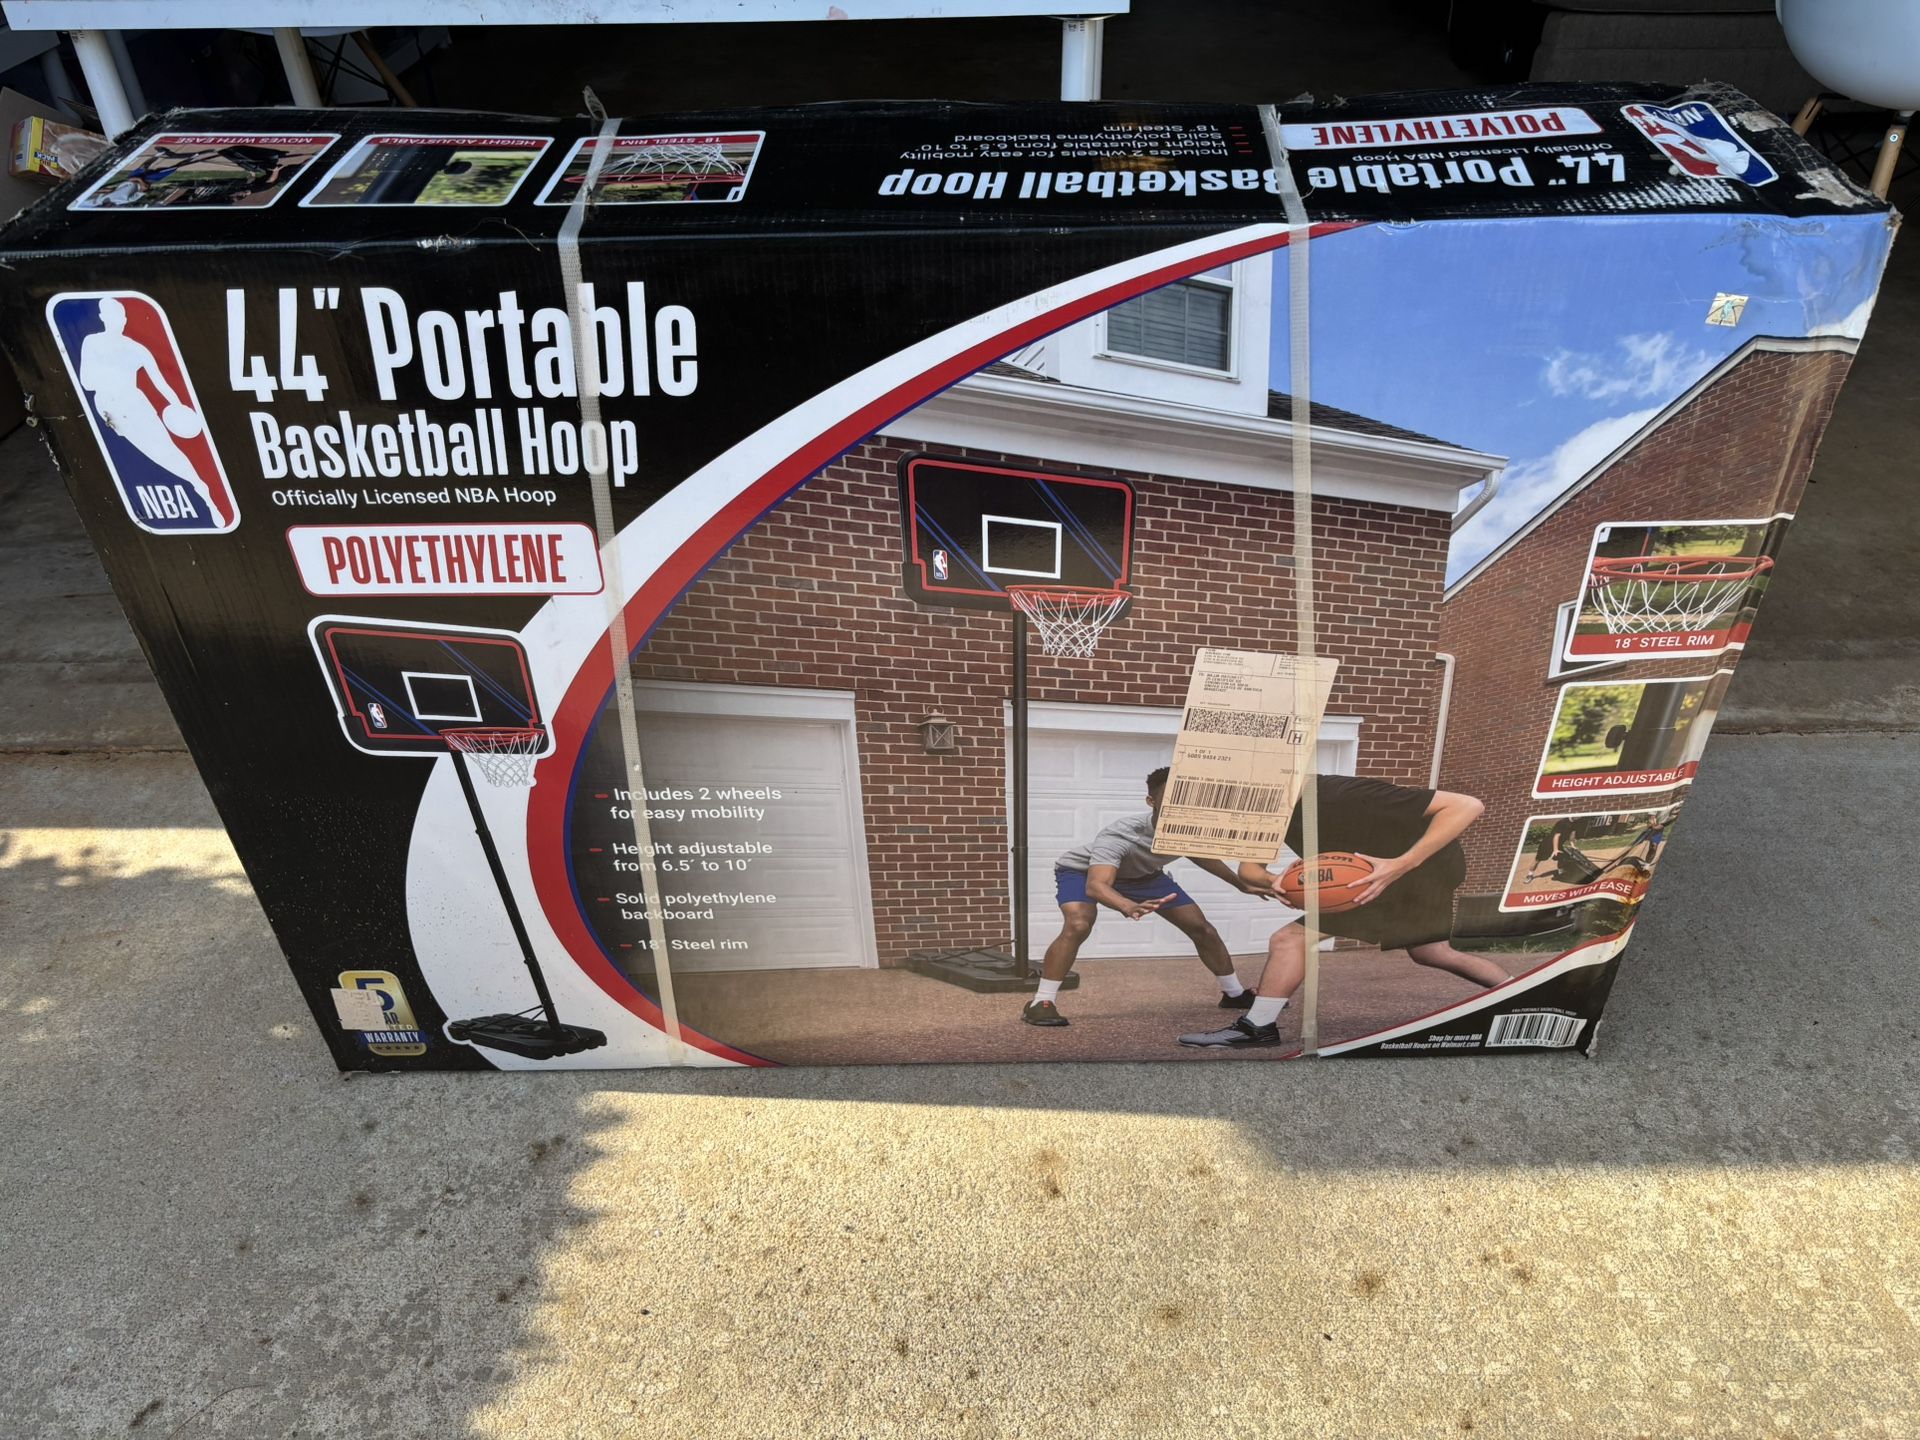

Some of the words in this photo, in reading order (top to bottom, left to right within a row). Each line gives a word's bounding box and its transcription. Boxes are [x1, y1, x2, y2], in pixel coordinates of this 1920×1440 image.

[1312, 112, 1566, 145] POLYETHYLENE
[479, 138, 535, 146] HEIGHT
[955, 134, 1050, 142] backboard
[1056, 132, 1170, 141] polyethylene
[1063, 140, 1159, 148] adjustable
[1165, 140, 1226, 148] Height
[1535, 143, 1612, 155] Officially
[900, 151, 974, 160] mobility
[980, 150, 1023, 158] easy
[1029, 150, 1054, 158] for
[1061, 149, 1126, 157] wheels
[1131, 149, 1143, 157] 2
[1150, 148, 1228, 156] Includes
[1352, 153, 1404, 163] Hoop
[1408, 151, 1444, 160] NBA
[1450, 148, 1529, 158] Licensed
[1549, 152, 1626, 185] 44"
[1307, 156, 1534, 194] Portable
[878, 168, 1008, 200] Hoop
[1019, 169, 1283, 198] Basketball
[226, 287, 341, 402] 44"
[360, 281, 699, 401] Portable
[249, 408, 509, 479] Basketball
[517, 407, 639, 488] Hoop
[136, 484, 199, 519] NBA
[272, 489, 358, 508] Officially
[363, 487, 450, 505] Licensed
[455, 488, 499, 504] NBA
[504, 487, 557, 506] Hoop
[322, 534, 567, 585] POLYETHYLENE
[1640, 636, 1682, 648] STEEL
[1687, 635, 1715, 646] RIM
[1293, 733, 1303, 743] H
[1552, 776, 1603, 788] HEIGHT
[1603, 767, 1685, 785] ADJUSTABLE
[613, 787, 694, 801] Includes
[699, 787, 711, 800] 2
[716, 787, 782, 800] wheels
[610, 806, 636, 819] for
[643, 807, 685, 822] easy
[691, 805, 765, 821] mobility
[612, 842, 674, 857] Height
[678, 841, 773, 857] adjustable
[613, 859, 656, 872] from
[701, 859, 719, 872] to
[1523, 891, 1566, 903] MOVES
[1568, 885, 1597, 898] WITH
[1600, 881, 1633, 894] EASE
[616, 892, 660, 905] Solid
[665, 892, 776, 907] polyethylene
[622, 908, 714, 921] backboard
[671, 938, 715, 950] Steel
[720, 938, 748, 950] rim
[364, 1032, 420, 1042] WARRANTY
[1380, 1042, 1413, 1050] Basketball
[1441, 1041, 1480, 1049] Walmart.com
